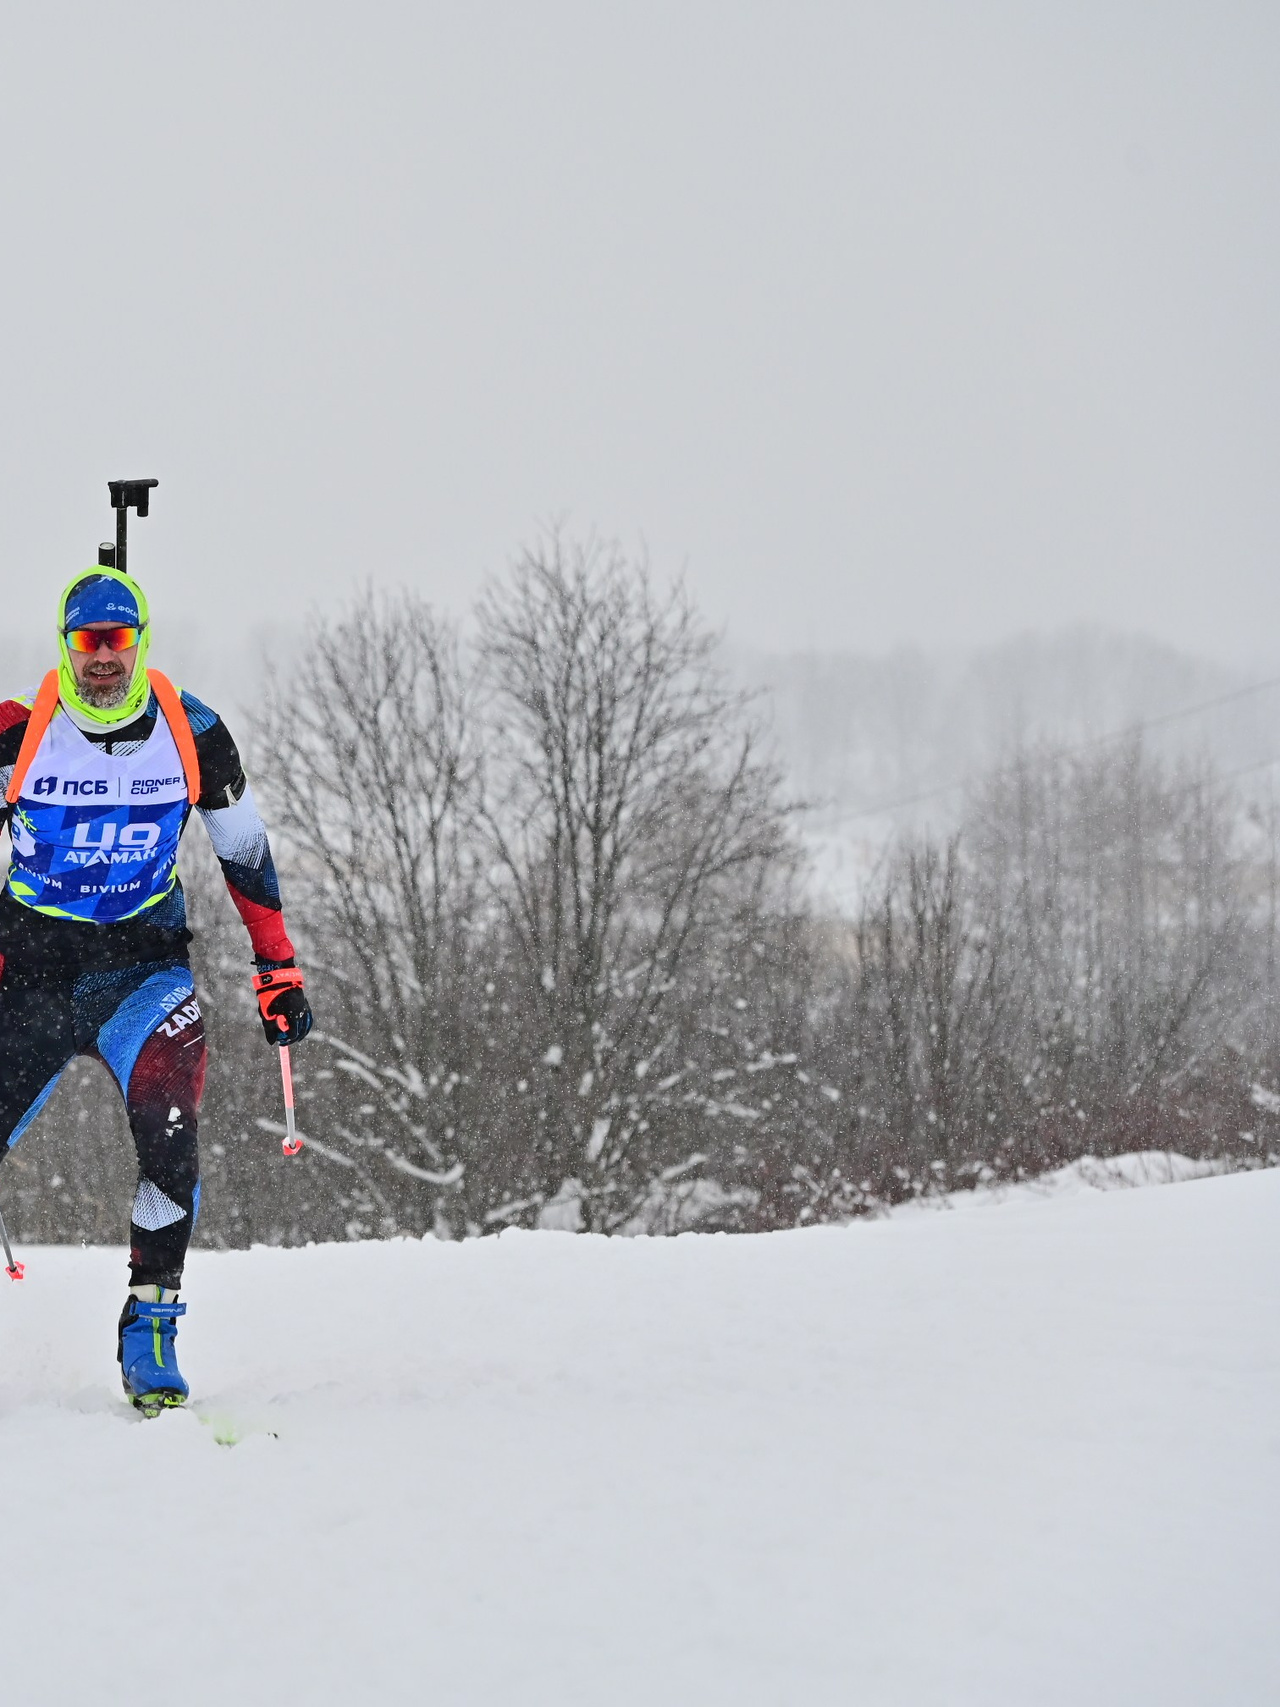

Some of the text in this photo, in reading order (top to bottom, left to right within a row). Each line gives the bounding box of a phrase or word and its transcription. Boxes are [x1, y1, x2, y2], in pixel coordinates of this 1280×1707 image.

[63, 780, 109, 796] ПСБ
[132, 777, 181, 787] PIONER
[130, 787, 159, 795] CUP
[72, 823, 161, 851] 49
[80, 880, 141, 893] BIVIUM
